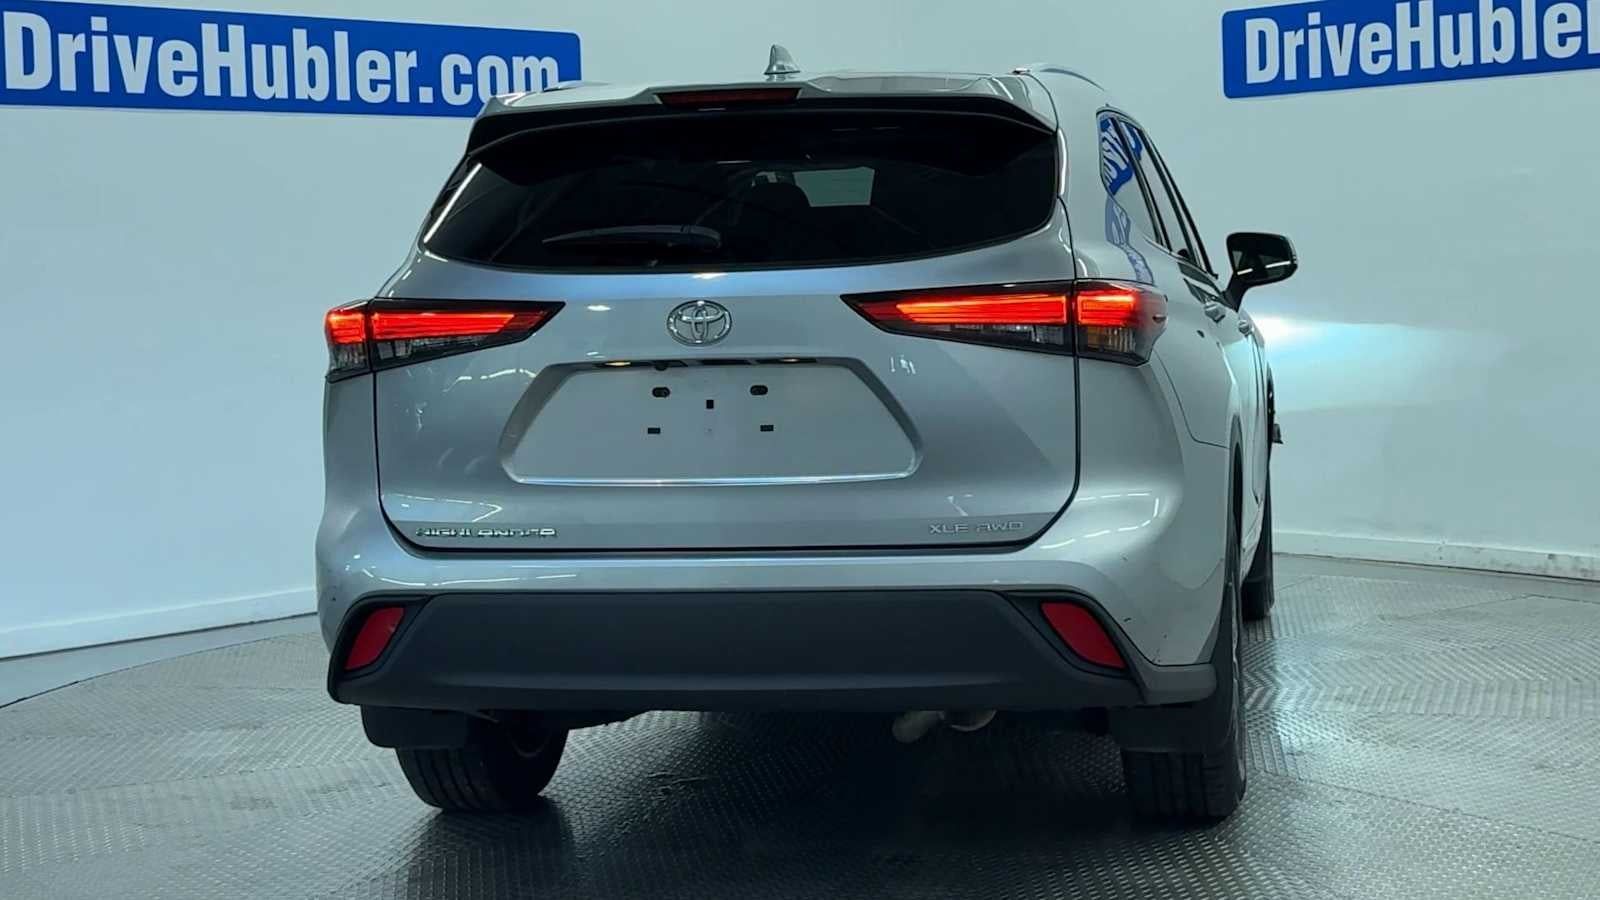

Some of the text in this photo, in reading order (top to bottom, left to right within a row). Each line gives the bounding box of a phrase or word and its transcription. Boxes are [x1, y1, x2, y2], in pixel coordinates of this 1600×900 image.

[3, 11, 560, 105] DriveHubler.com
[929, 521, 1024, 534] XLE AWD
